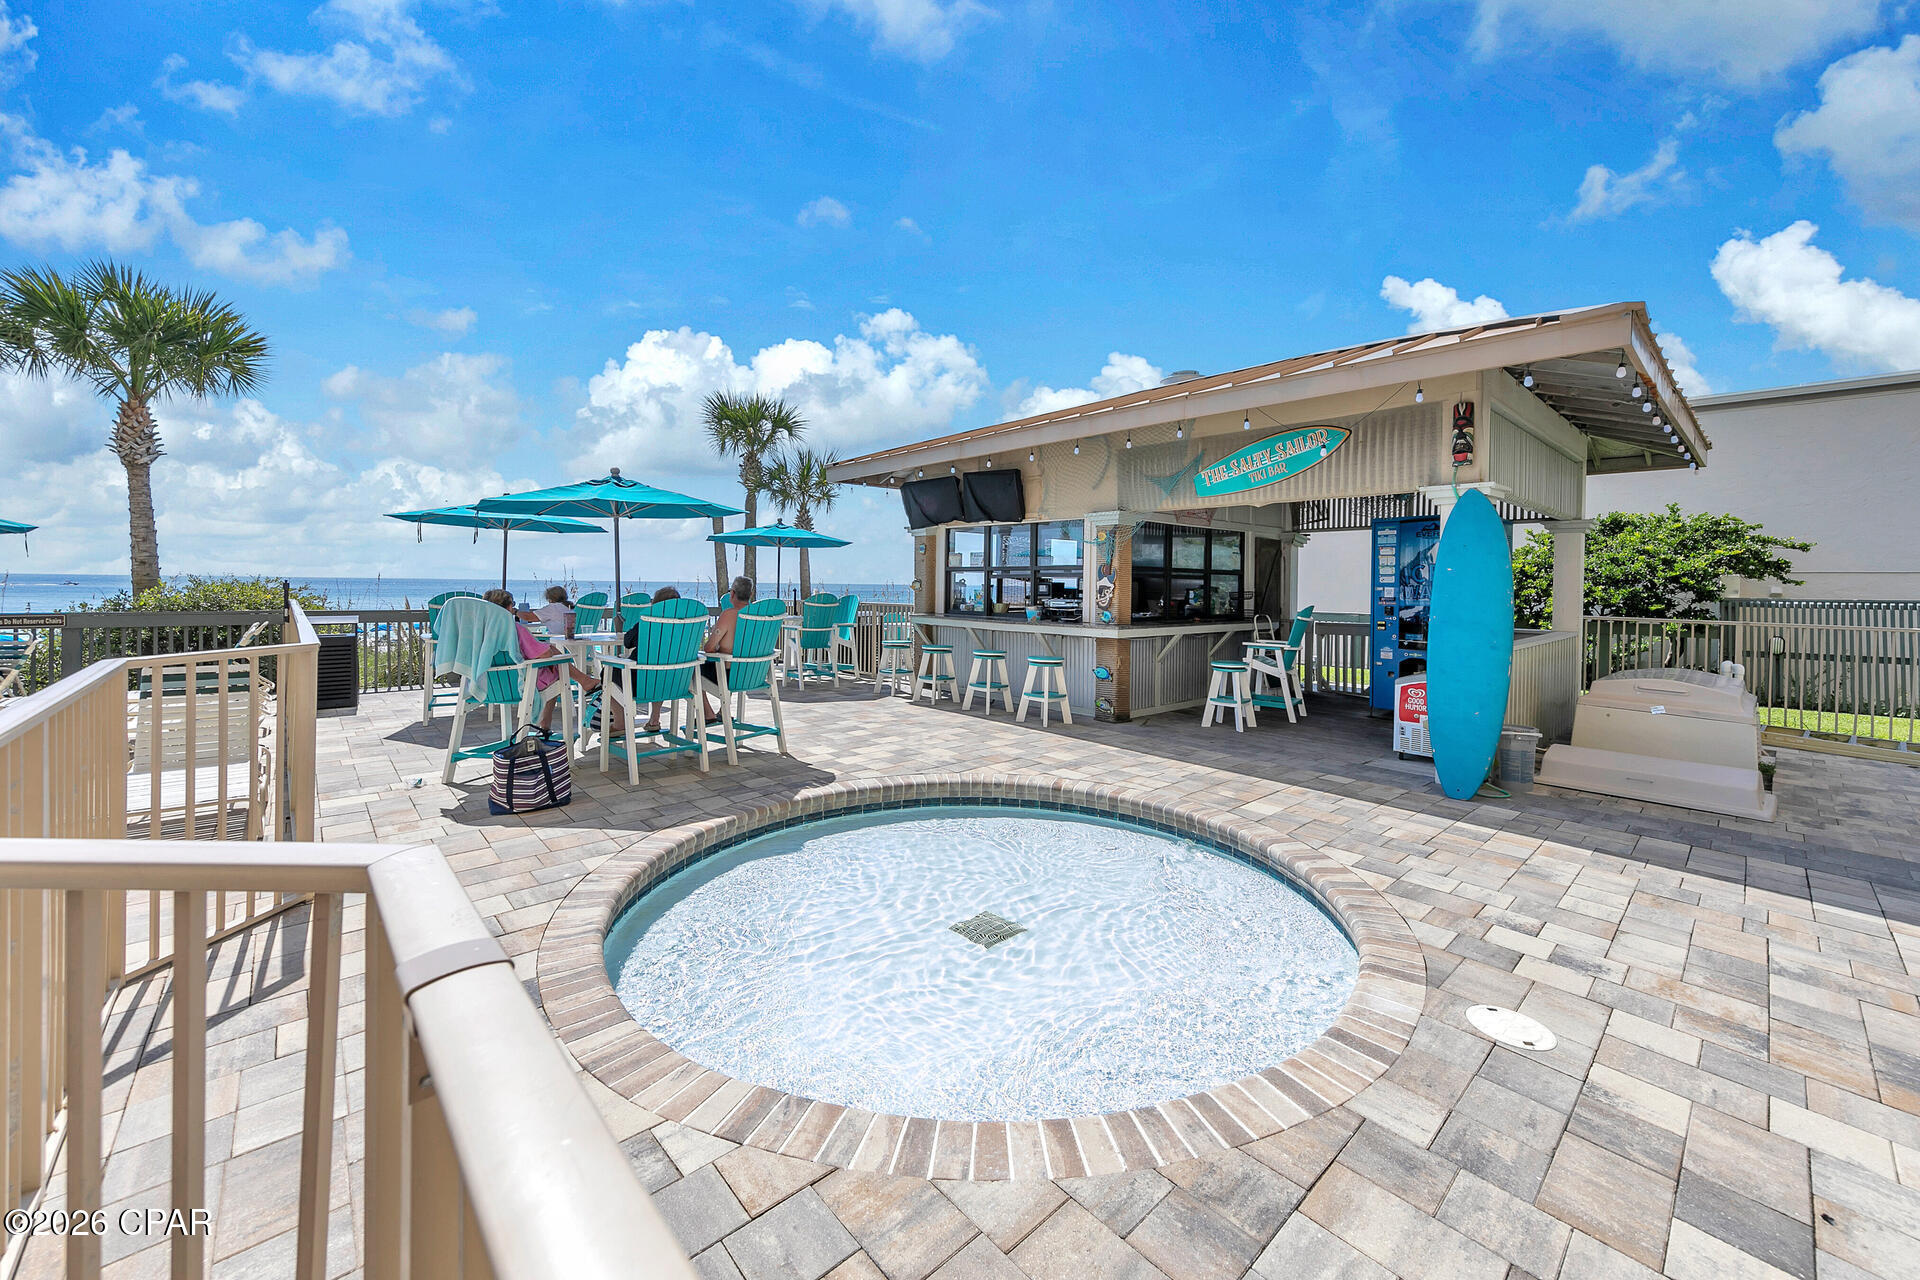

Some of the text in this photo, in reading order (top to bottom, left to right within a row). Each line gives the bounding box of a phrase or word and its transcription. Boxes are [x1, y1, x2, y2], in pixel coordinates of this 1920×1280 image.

[1201, 428, 1330, 486] THE SALTY SAILOR
[1248, 462, 1288, 483] TIKI BAR
[1405, 704, 1428, 712] HUMOR
[1408, 697, 1425, 705] GOOD
